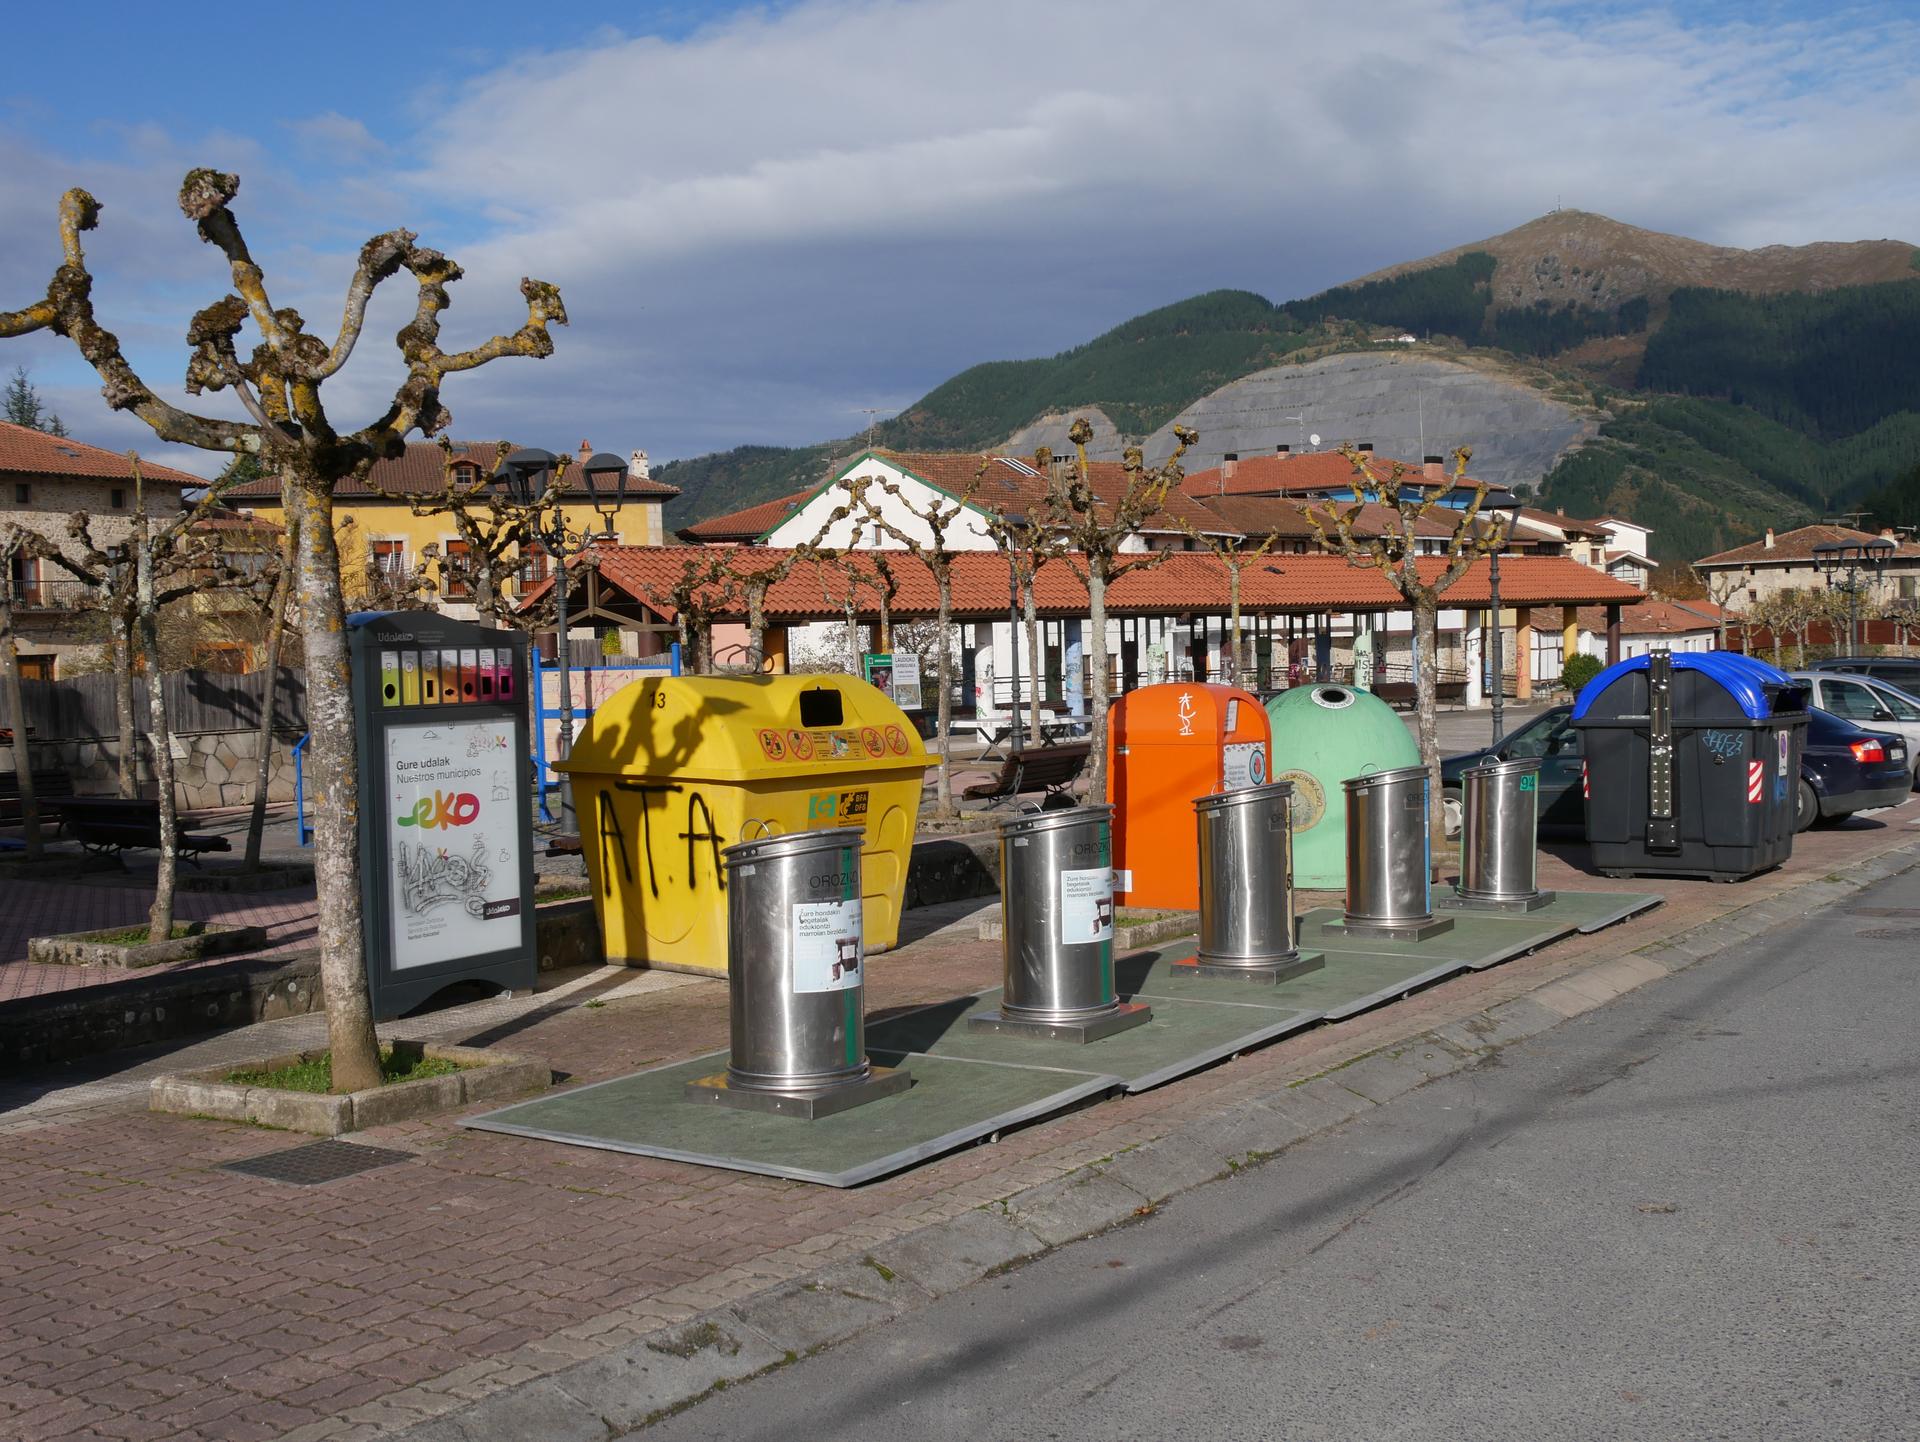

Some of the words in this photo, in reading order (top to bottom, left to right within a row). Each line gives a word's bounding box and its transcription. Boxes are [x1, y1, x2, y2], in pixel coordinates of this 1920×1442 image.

[649, 691, 666, 709] 13
[396, 760, 418, 771] Gure
[420, 756, 450, 769] udalak
[396, 772, 435, 784] Nuestros
[436, 768, 481, 780] municipios
[1521, 776, 1535, 790] 94
[397, 789, 480, 831] eko
[600, 780, 727, 898] ATA
